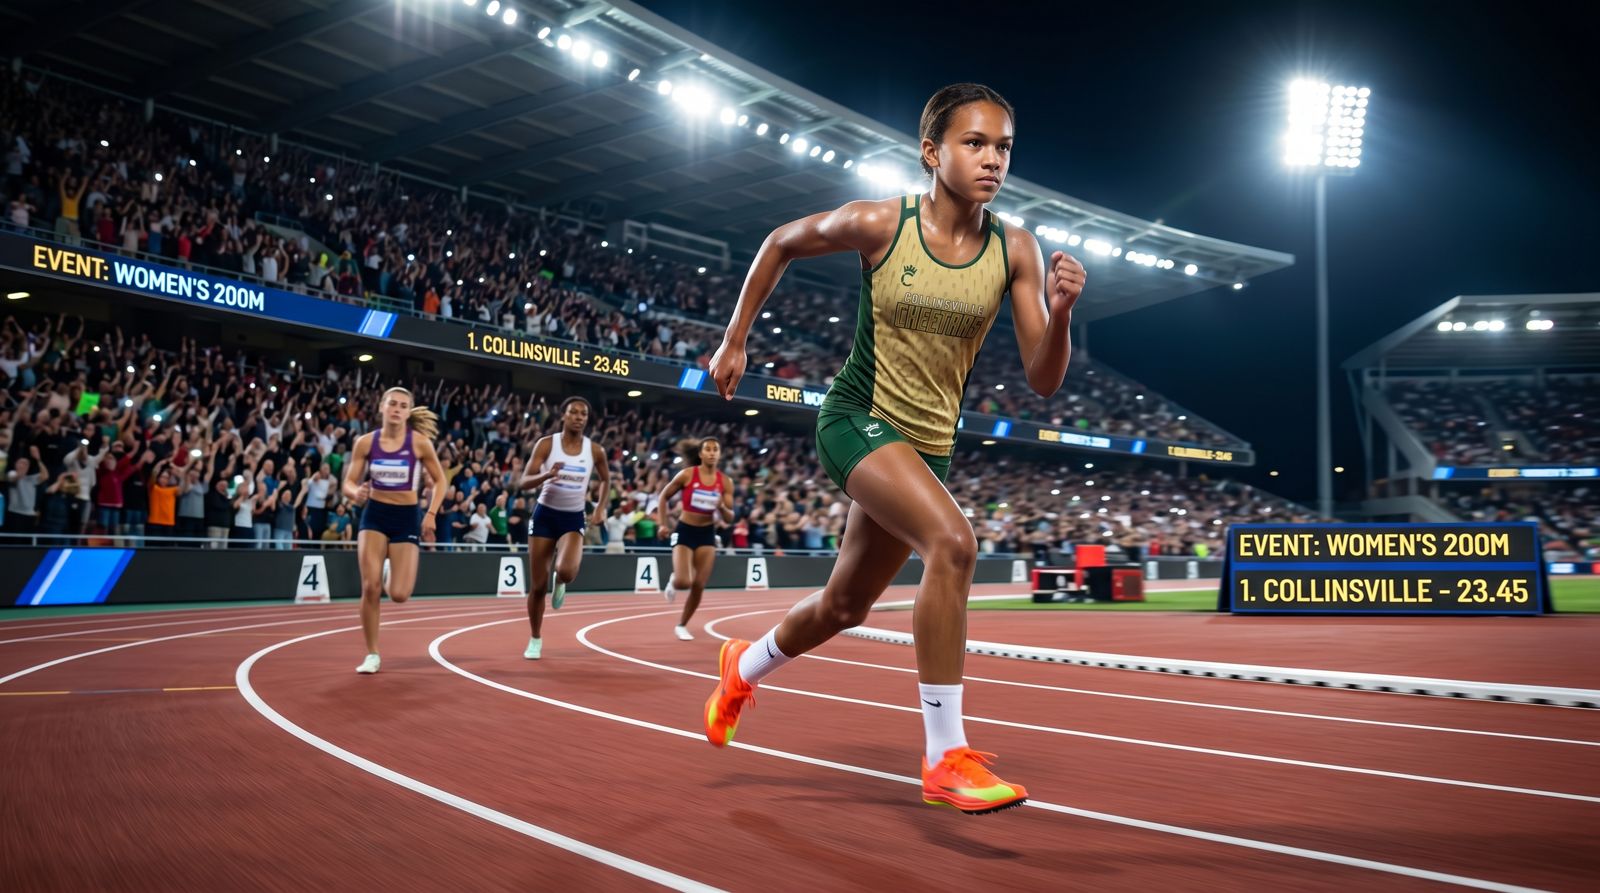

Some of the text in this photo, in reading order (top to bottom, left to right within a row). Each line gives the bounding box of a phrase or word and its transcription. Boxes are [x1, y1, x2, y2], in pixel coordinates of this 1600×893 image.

[34, 245, 264, 311] EVENT: WOMEN'S 200M
[904, 292, 984, 315] COLLINSVILLE
[467, 332, 479, 351] 1.
[482, 336, 581, 367] COLLINSVILLE
[593, 355, 630, 376] 23.45
[767, 385, 802, 403] EVENT:
[1239, 533, 1510, 557] EVENT: WOMEN'S 200M
[303, 564, 319, 591] 4
[503, 564, 518, 587] 3
[640, 564, 653, 585] 4
[752, 564, 762, 582] 5
[1239, 579, 1256, 602] 1.
[1263, 579, 1433, 603] COLLINSVILLE
[1457, 579, 1529, 603] 23.45
